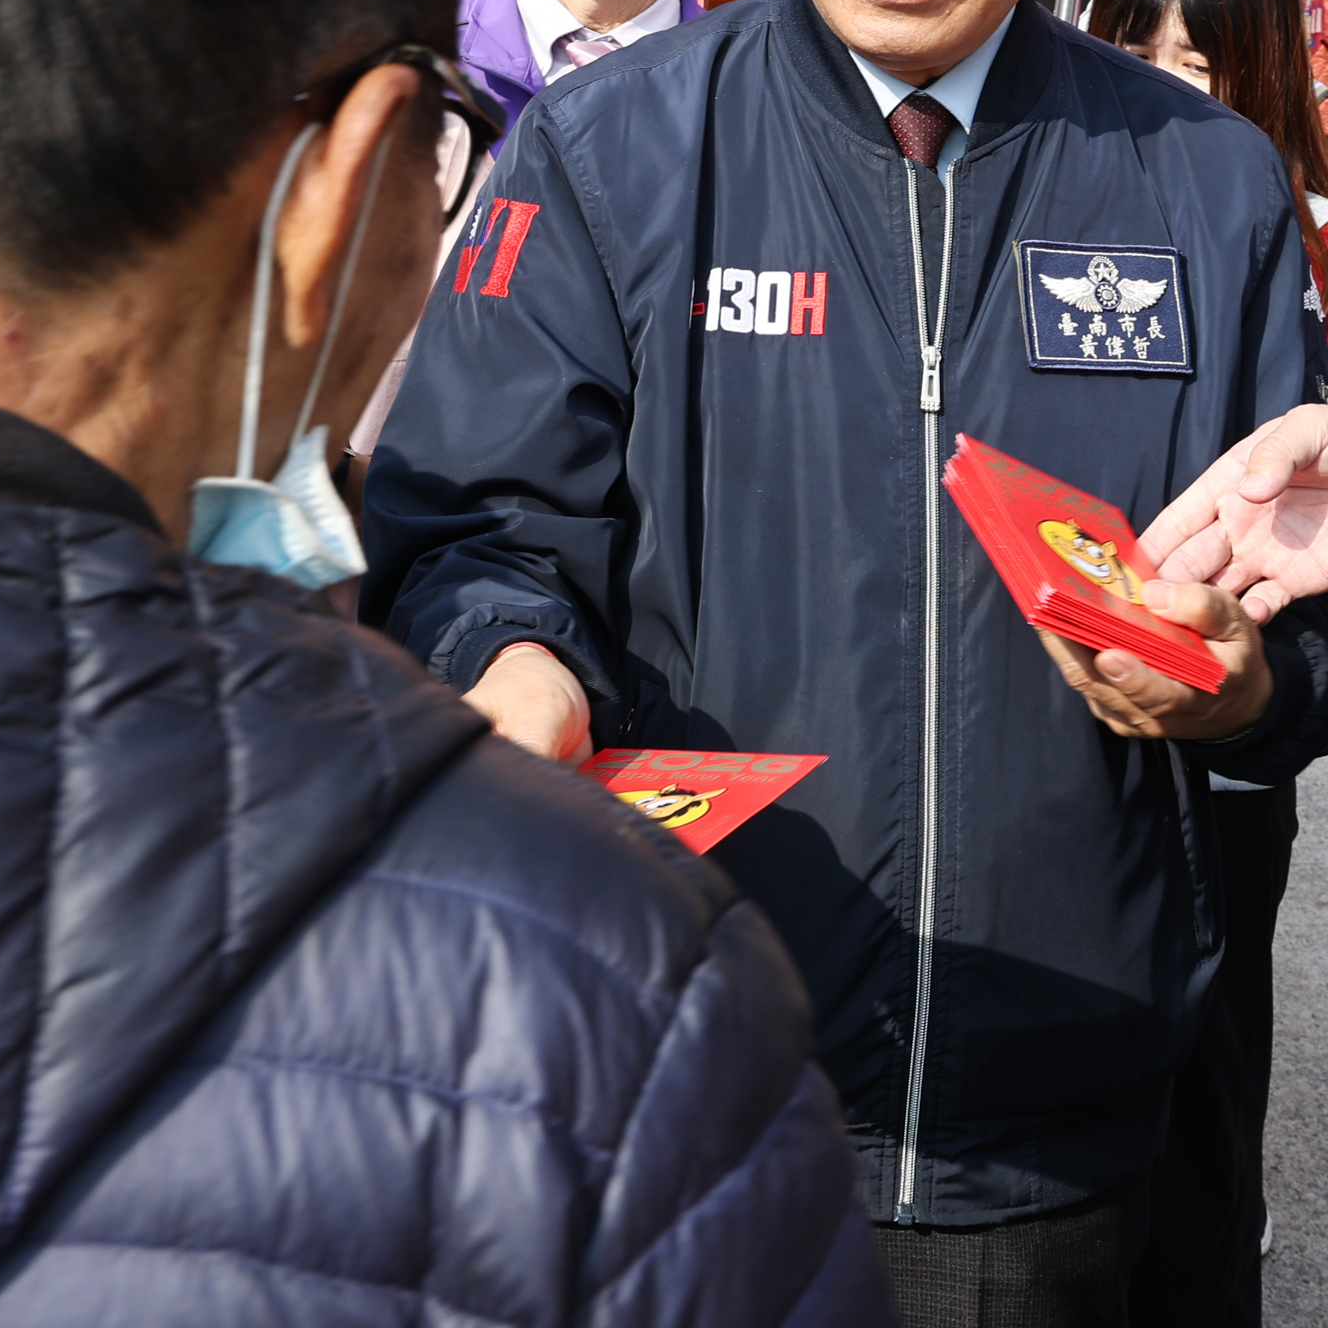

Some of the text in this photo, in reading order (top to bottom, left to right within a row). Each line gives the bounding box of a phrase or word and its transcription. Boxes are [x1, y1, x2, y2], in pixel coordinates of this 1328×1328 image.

[689, 267, 828, 335] -130H
[1057, 312, 1166, 339] 臺南市長
[1078, 333, 1151, 359] 黃偉哲
[595, 751, 806, 774] 2026
